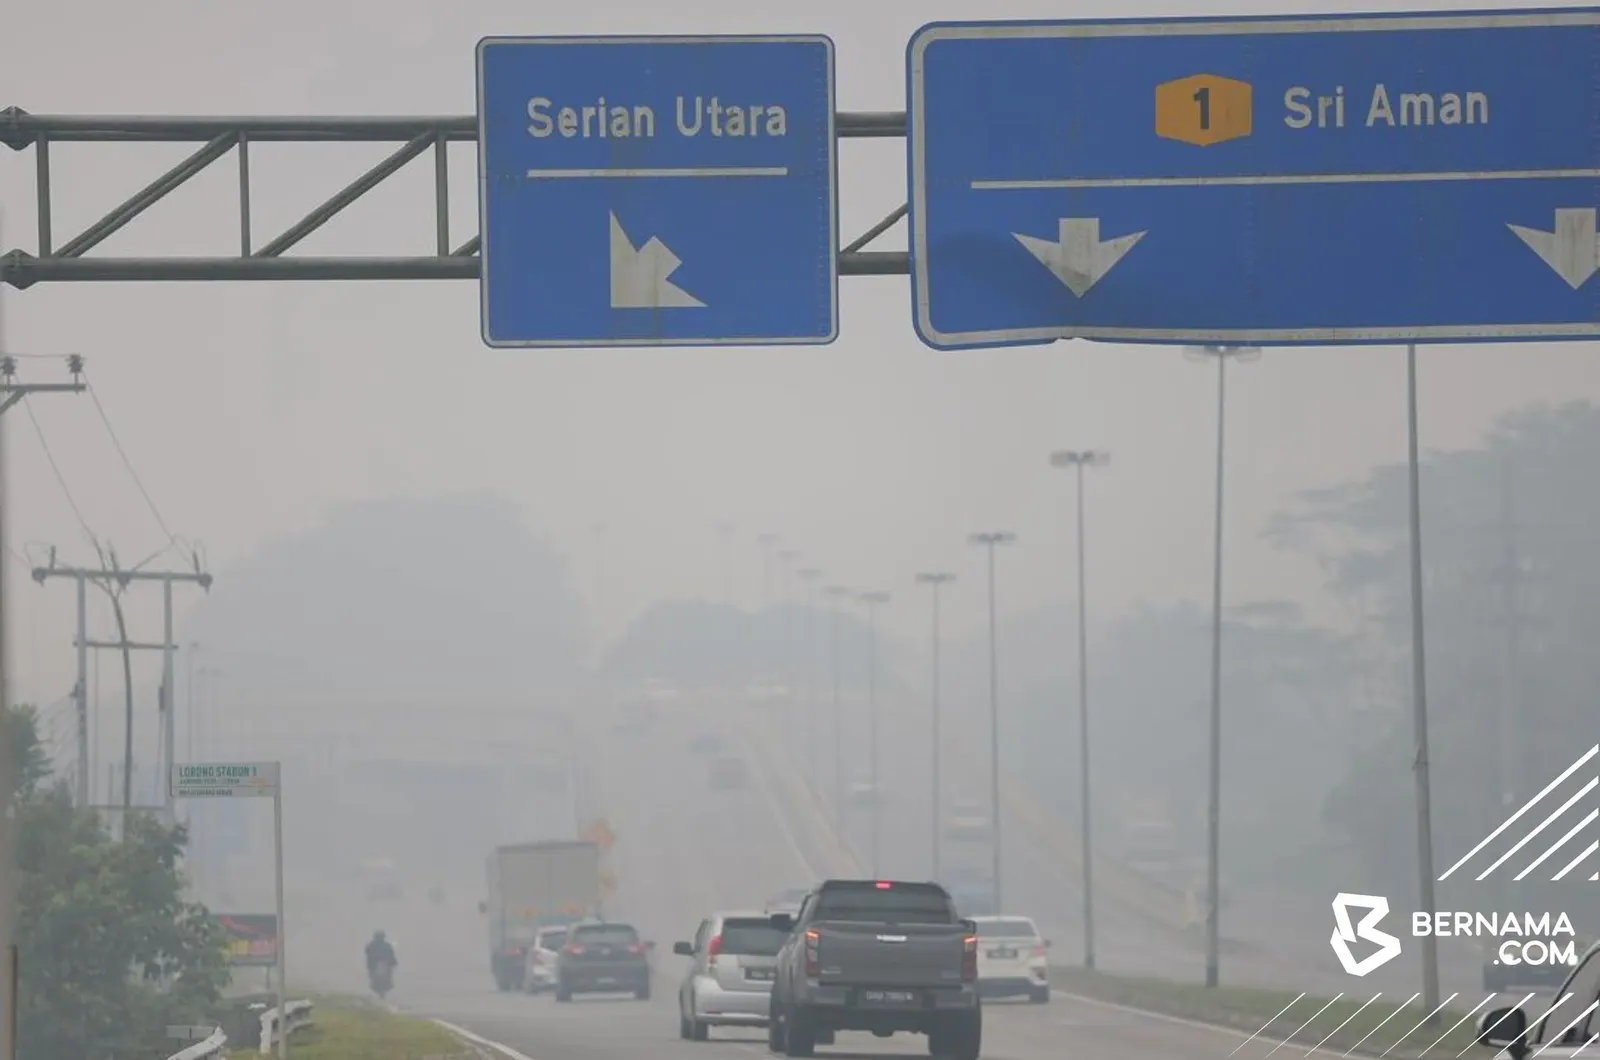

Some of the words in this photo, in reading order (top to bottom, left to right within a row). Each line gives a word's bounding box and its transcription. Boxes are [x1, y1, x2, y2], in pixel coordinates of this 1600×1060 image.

[526, 97, 655, 138] Serian
[676, 96, 788, 137] Utara
[1193, 87, 1210, 130] 1
[1283, 86, 1345, 129] Sri
[1365, 83, 1490, 128] Aman
[179, 766, 214, 777] LORONG
